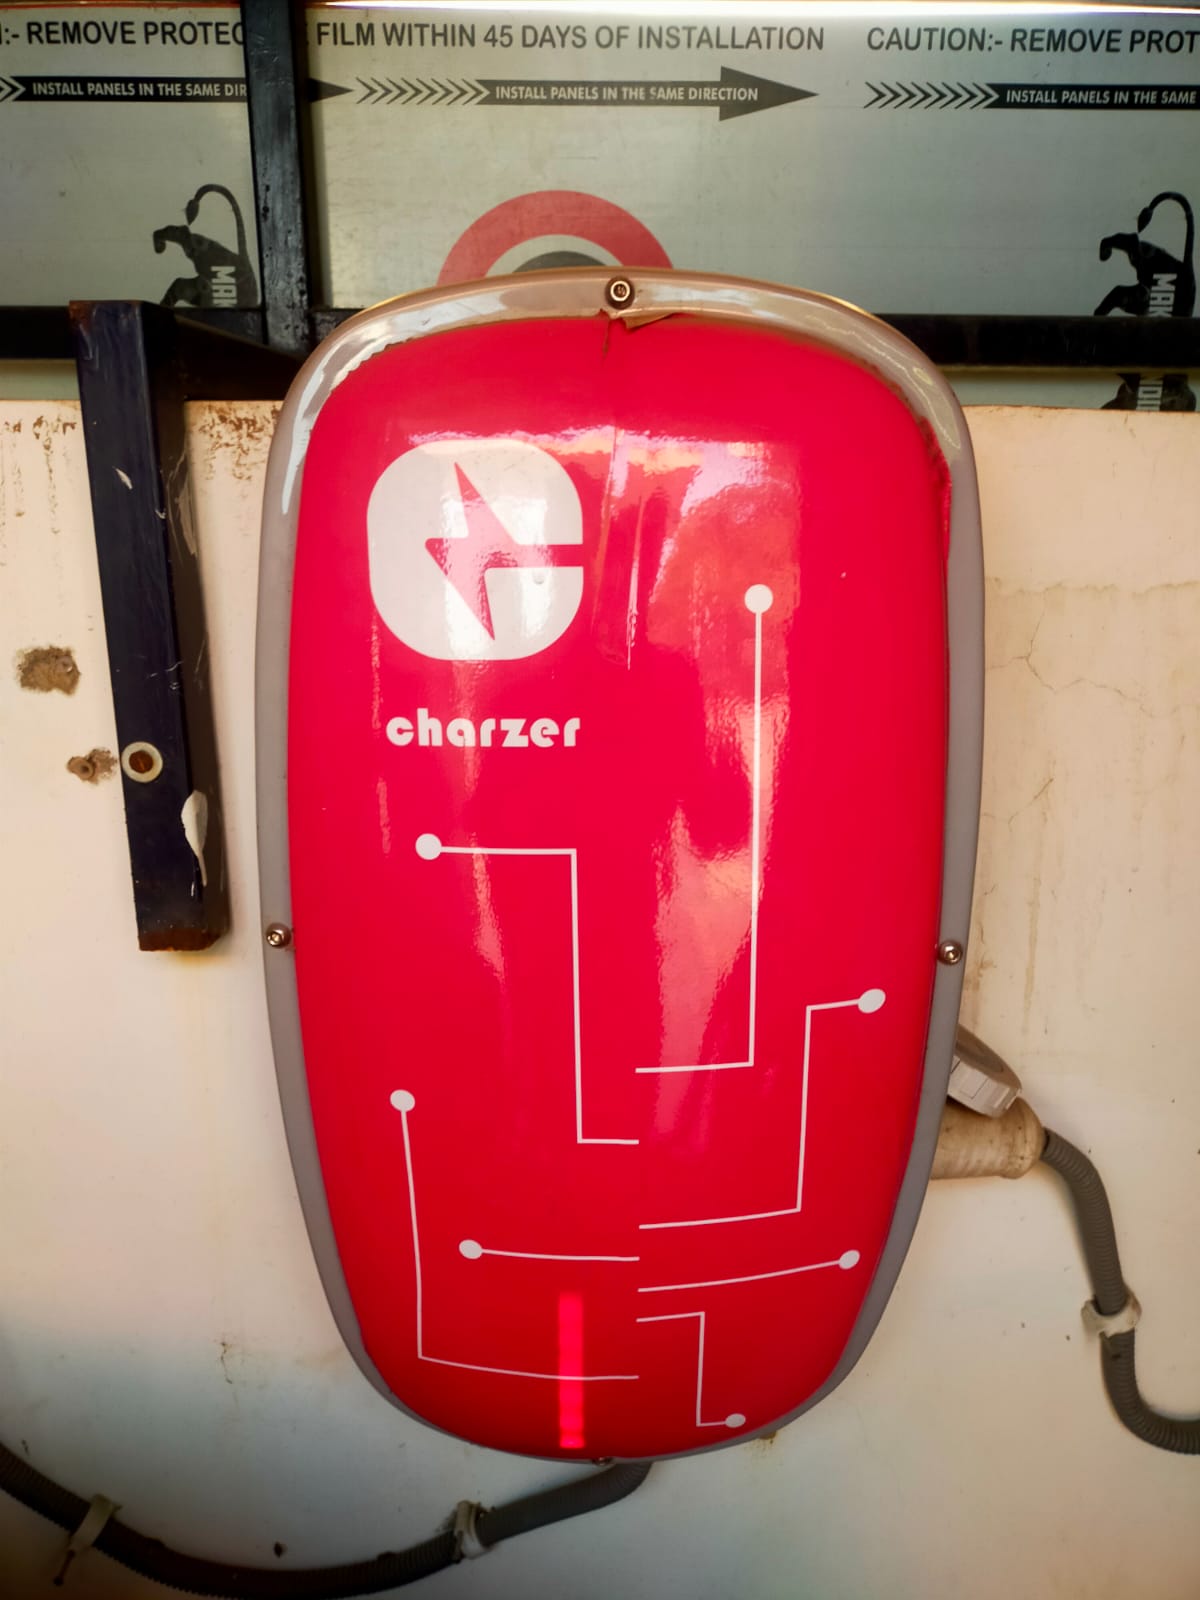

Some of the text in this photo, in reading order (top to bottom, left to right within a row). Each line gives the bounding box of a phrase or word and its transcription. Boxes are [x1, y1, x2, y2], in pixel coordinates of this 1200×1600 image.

[26, 20, 136, 45] REMOVE
[316, 22, 375, 46] FILM
[382, 23, 476, 48] WITHIN
[483, 24, 514, 48] 45
[521, 25, 588, 49] DAYS
[595, 25, 630, 50] OF
[637, 26, 824, 51] INSTALLATION
[866, 27, 1200, 54] CAUTION:- REMOVE PROT
[32, 82, 83, 96] INSTALL
[87, 83, 135, 96] PANELS
[138, 83, 153, 96] IN
[157, 83, 182, 97] THE
[185, 83, 219, 97] SAME
[495, 86, 759, 101] INSTALL PANELS IN THE SAME DIRECTION
[1006, 89, 1197, 105] INSTALL PANELS IN THE SAME
[385, 707, 581, 748] charzer
